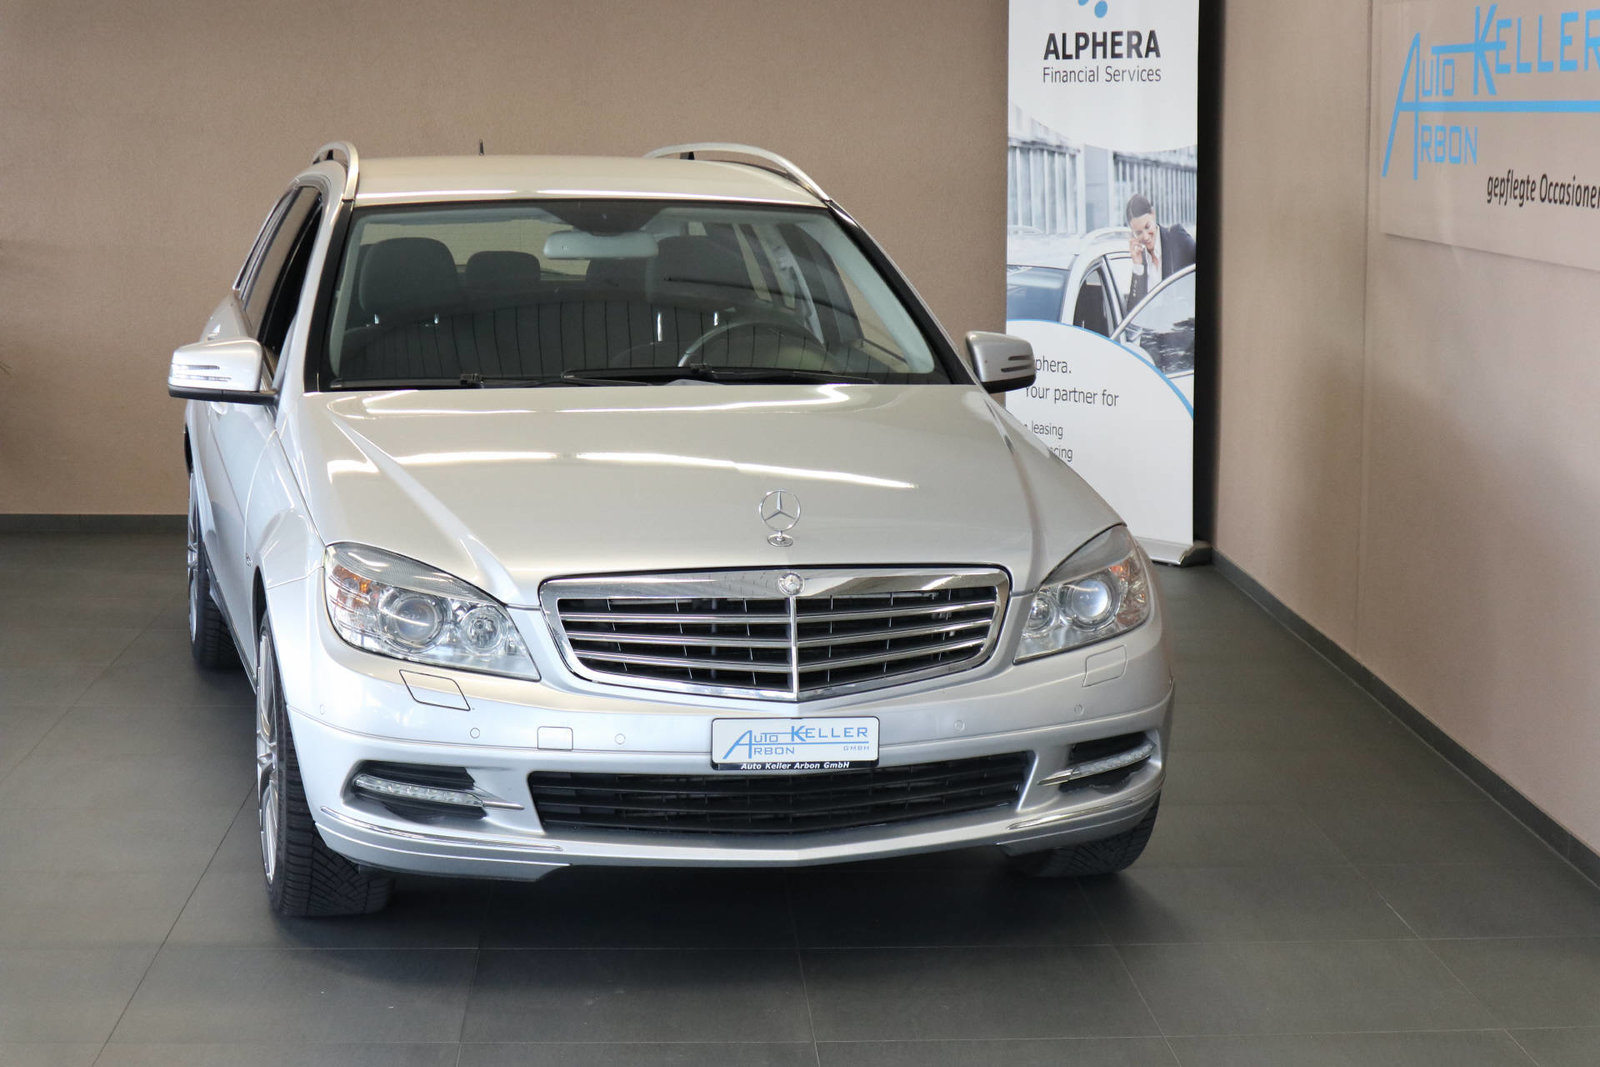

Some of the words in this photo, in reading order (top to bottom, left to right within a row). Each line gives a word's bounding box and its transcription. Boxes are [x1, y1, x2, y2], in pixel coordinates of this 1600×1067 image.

[1043, 30, 1161, 61] ALPHERA
[1473, 4, 1600, 95] KELLER
[1042, 66, 1099, 83] Financial
[1105, 65, 1162, 83] Services
[1487, 169, 1537, 207] gepflegte
[1540, 173, 1600, 209] Occasione
[1054, 387, 1098, 405] partner
[1102, 389, 1120, 407] for
[1031, 420, 1064, 440] leasing
[791, 725, 868, 742] KELLER
[765, 762, 791, 770] Keller
[794, 762, 820, 770] Arbon
[823, 761, 850, 769] GmbH
